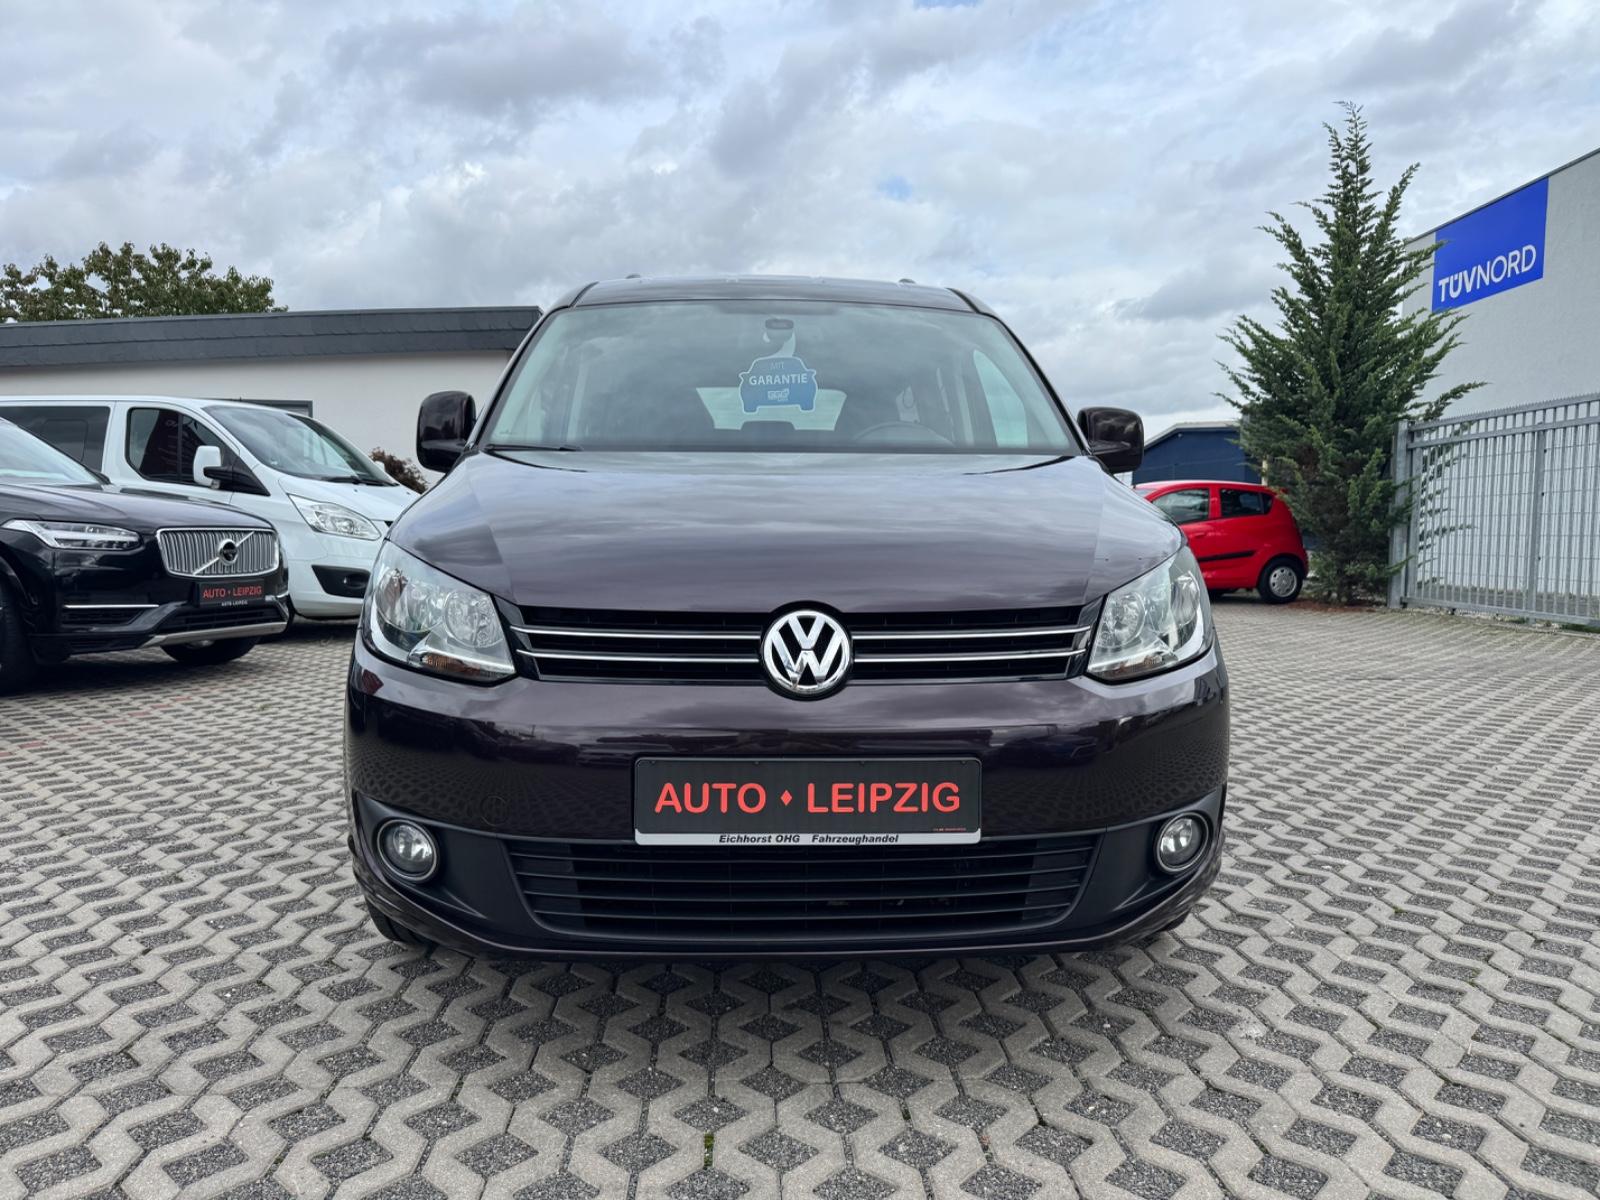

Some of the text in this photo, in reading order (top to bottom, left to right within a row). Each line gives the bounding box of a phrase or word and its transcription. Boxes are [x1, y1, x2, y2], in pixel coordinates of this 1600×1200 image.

[749, 373, 808, 386] GARANTIE
[203, 585, 262, 599] AUTO LEIPZIG
[654, 782, 961, 813] AUTO LEIPZIG
[719, 834, 899, 845] Eichhorst OHG Fahrzeughandel
